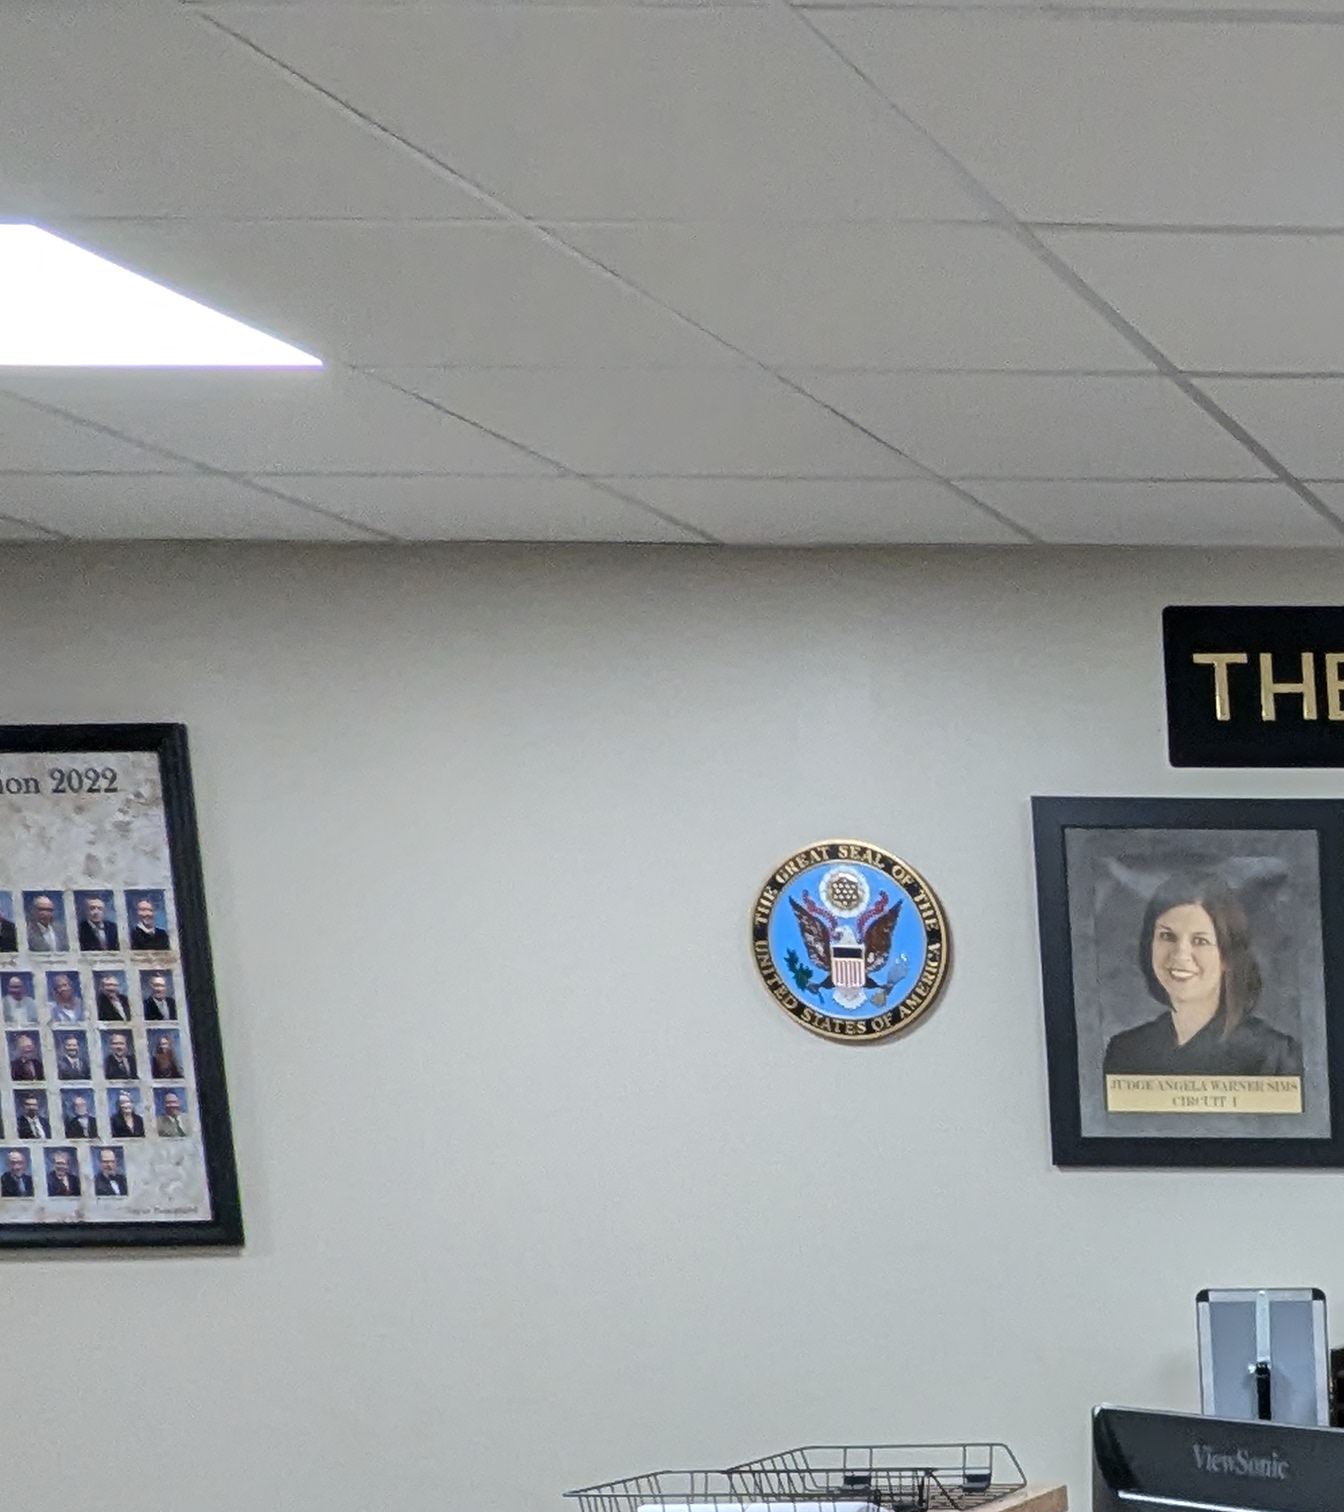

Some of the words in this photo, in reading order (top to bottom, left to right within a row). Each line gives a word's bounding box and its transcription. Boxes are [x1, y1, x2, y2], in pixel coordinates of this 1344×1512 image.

[49, 767, 118, 793] 2022
[754, 886, 779, 926] THE
[775, 846, 829, 885] GREAT
[838, 845, 885, 868] SEAL
[891, 867, 914, 889] OF
[914, 889, 940, 931] THE
[754, 940, 797, 1011] UNITED
[800, 1008, 867, 1035] STATES
[871, 1014, 893, 1032] OF
[898, 943, 942, 1019] AMERICA
[1110, 1079, 1151, 1091] JUDGE
[1172, 1096, 1227, 1107] CIRCUIT
[1193, 1444, 1289, 1480] ViewSonic
